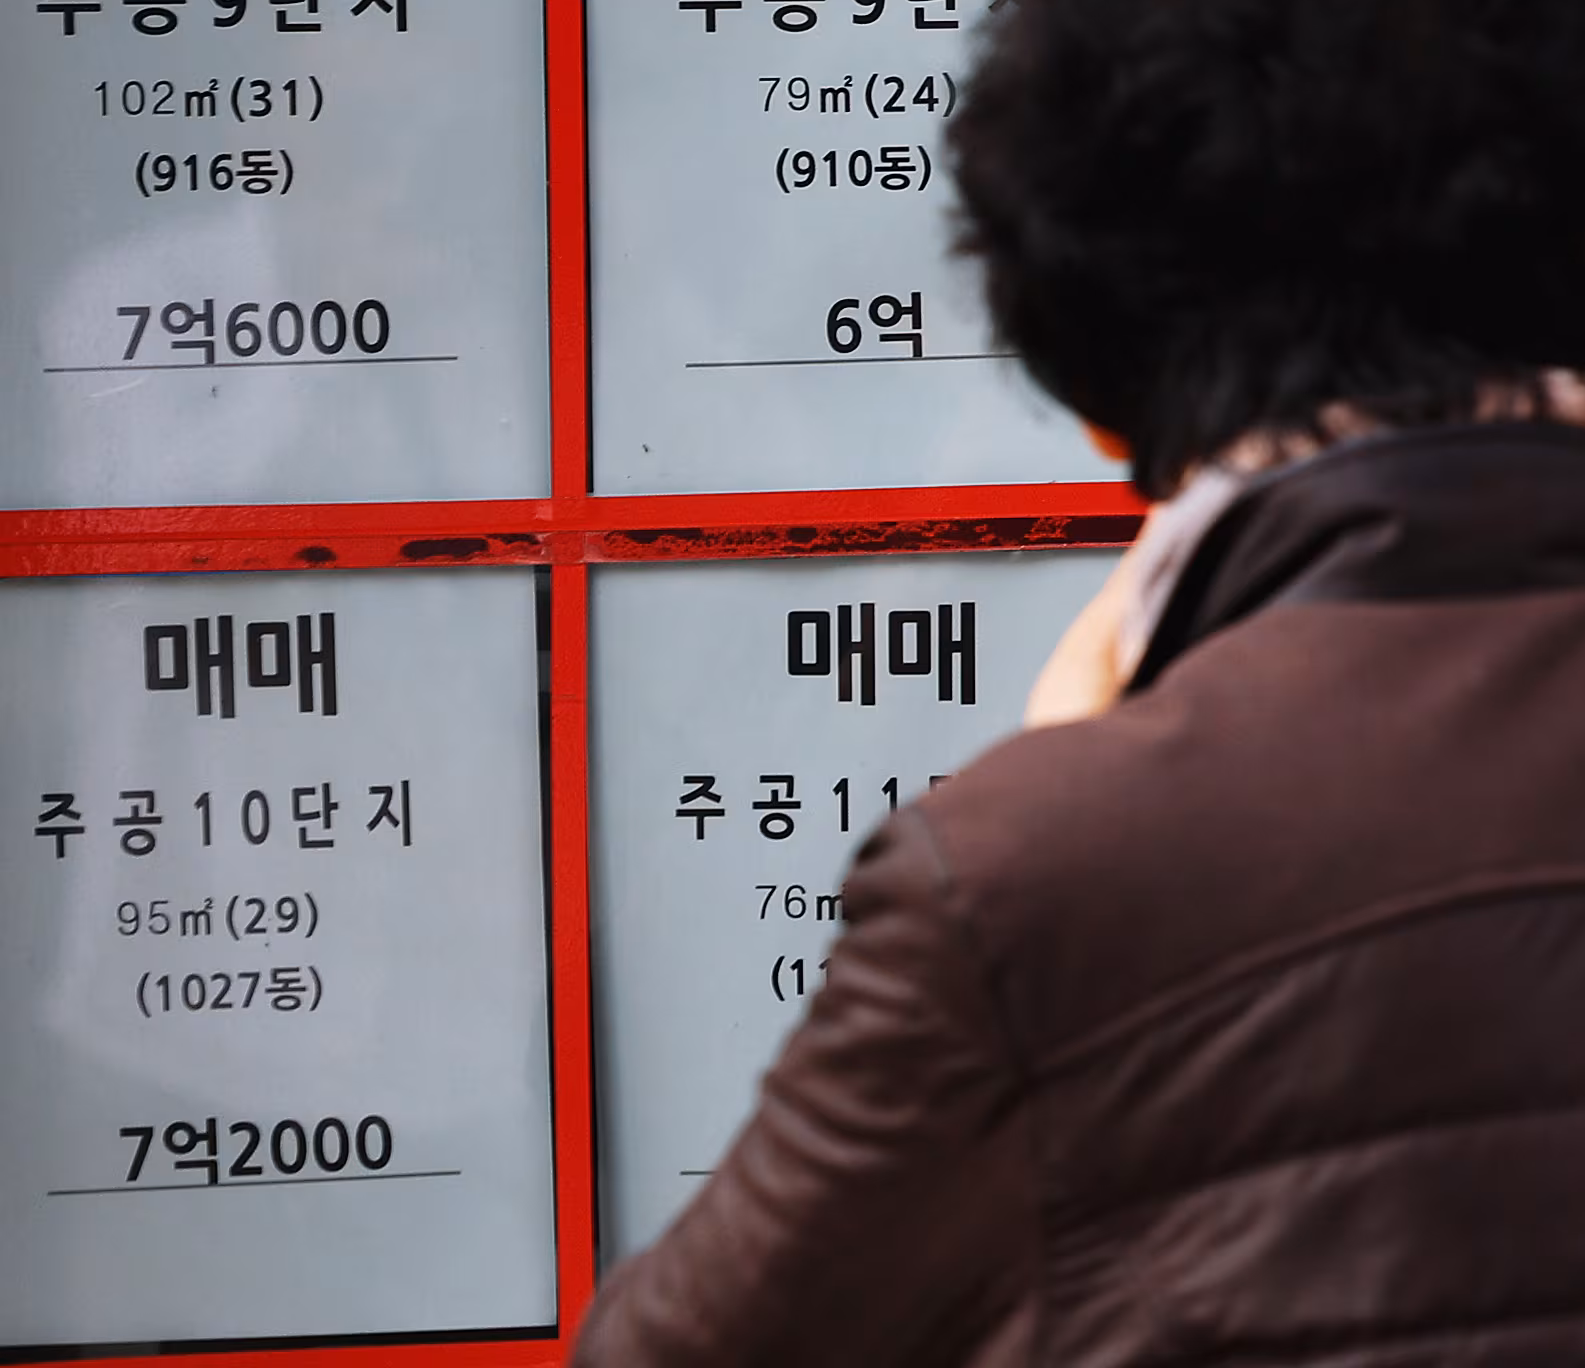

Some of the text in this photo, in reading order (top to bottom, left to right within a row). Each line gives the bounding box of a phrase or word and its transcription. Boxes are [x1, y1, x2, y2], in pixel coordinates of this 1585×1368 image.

[136, 150, 293, 197] (916동)
[776, 145, 931, 194] (910동)
[116, 299, 390, 364] 7억6000
[827, 292, 922, 361] 6억
[145, 612, 338, 719] 매매
[788, 602, 976, 705] 매매
[34, 780, 412, 858] 주공10단지
[675, 775, 950, 840] 주공11
[136, 967, 323, 1017] (1027동)
[119, 1115, 393, 1184] 7억2000
